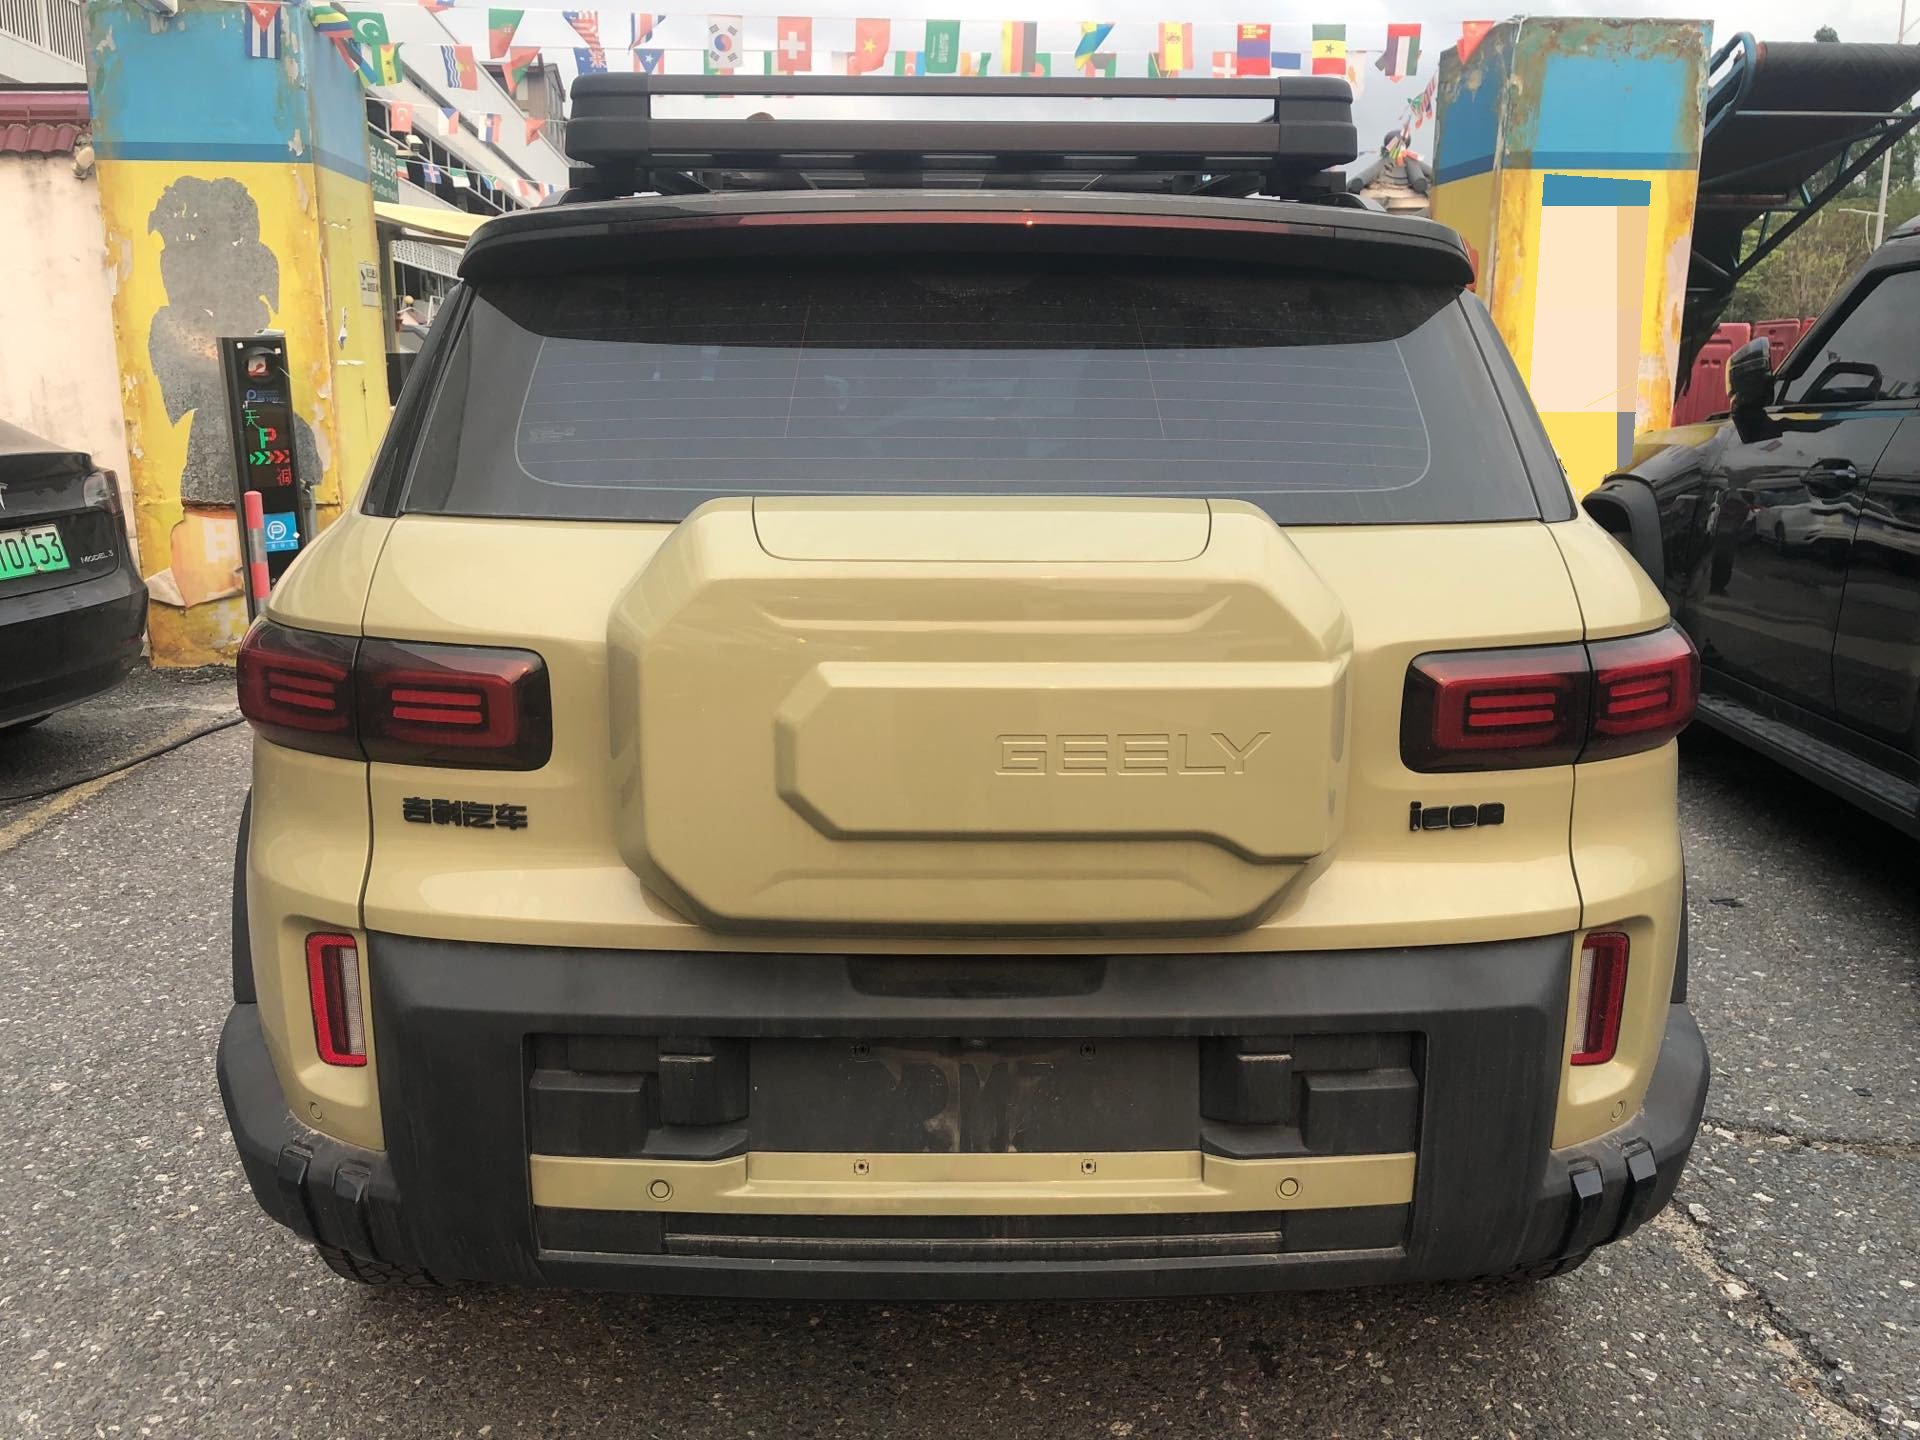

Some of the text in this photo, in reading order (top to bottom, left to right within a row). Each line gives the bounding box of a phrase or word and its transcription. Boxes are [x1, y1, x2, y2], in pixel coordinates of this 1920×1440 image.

[259, 427, 277, 449] P
[995, 731, 1271, 775] GEELY
[403, 797, 528, 829] 吉利汽车
[1410, 801, 1505, 831] icon
